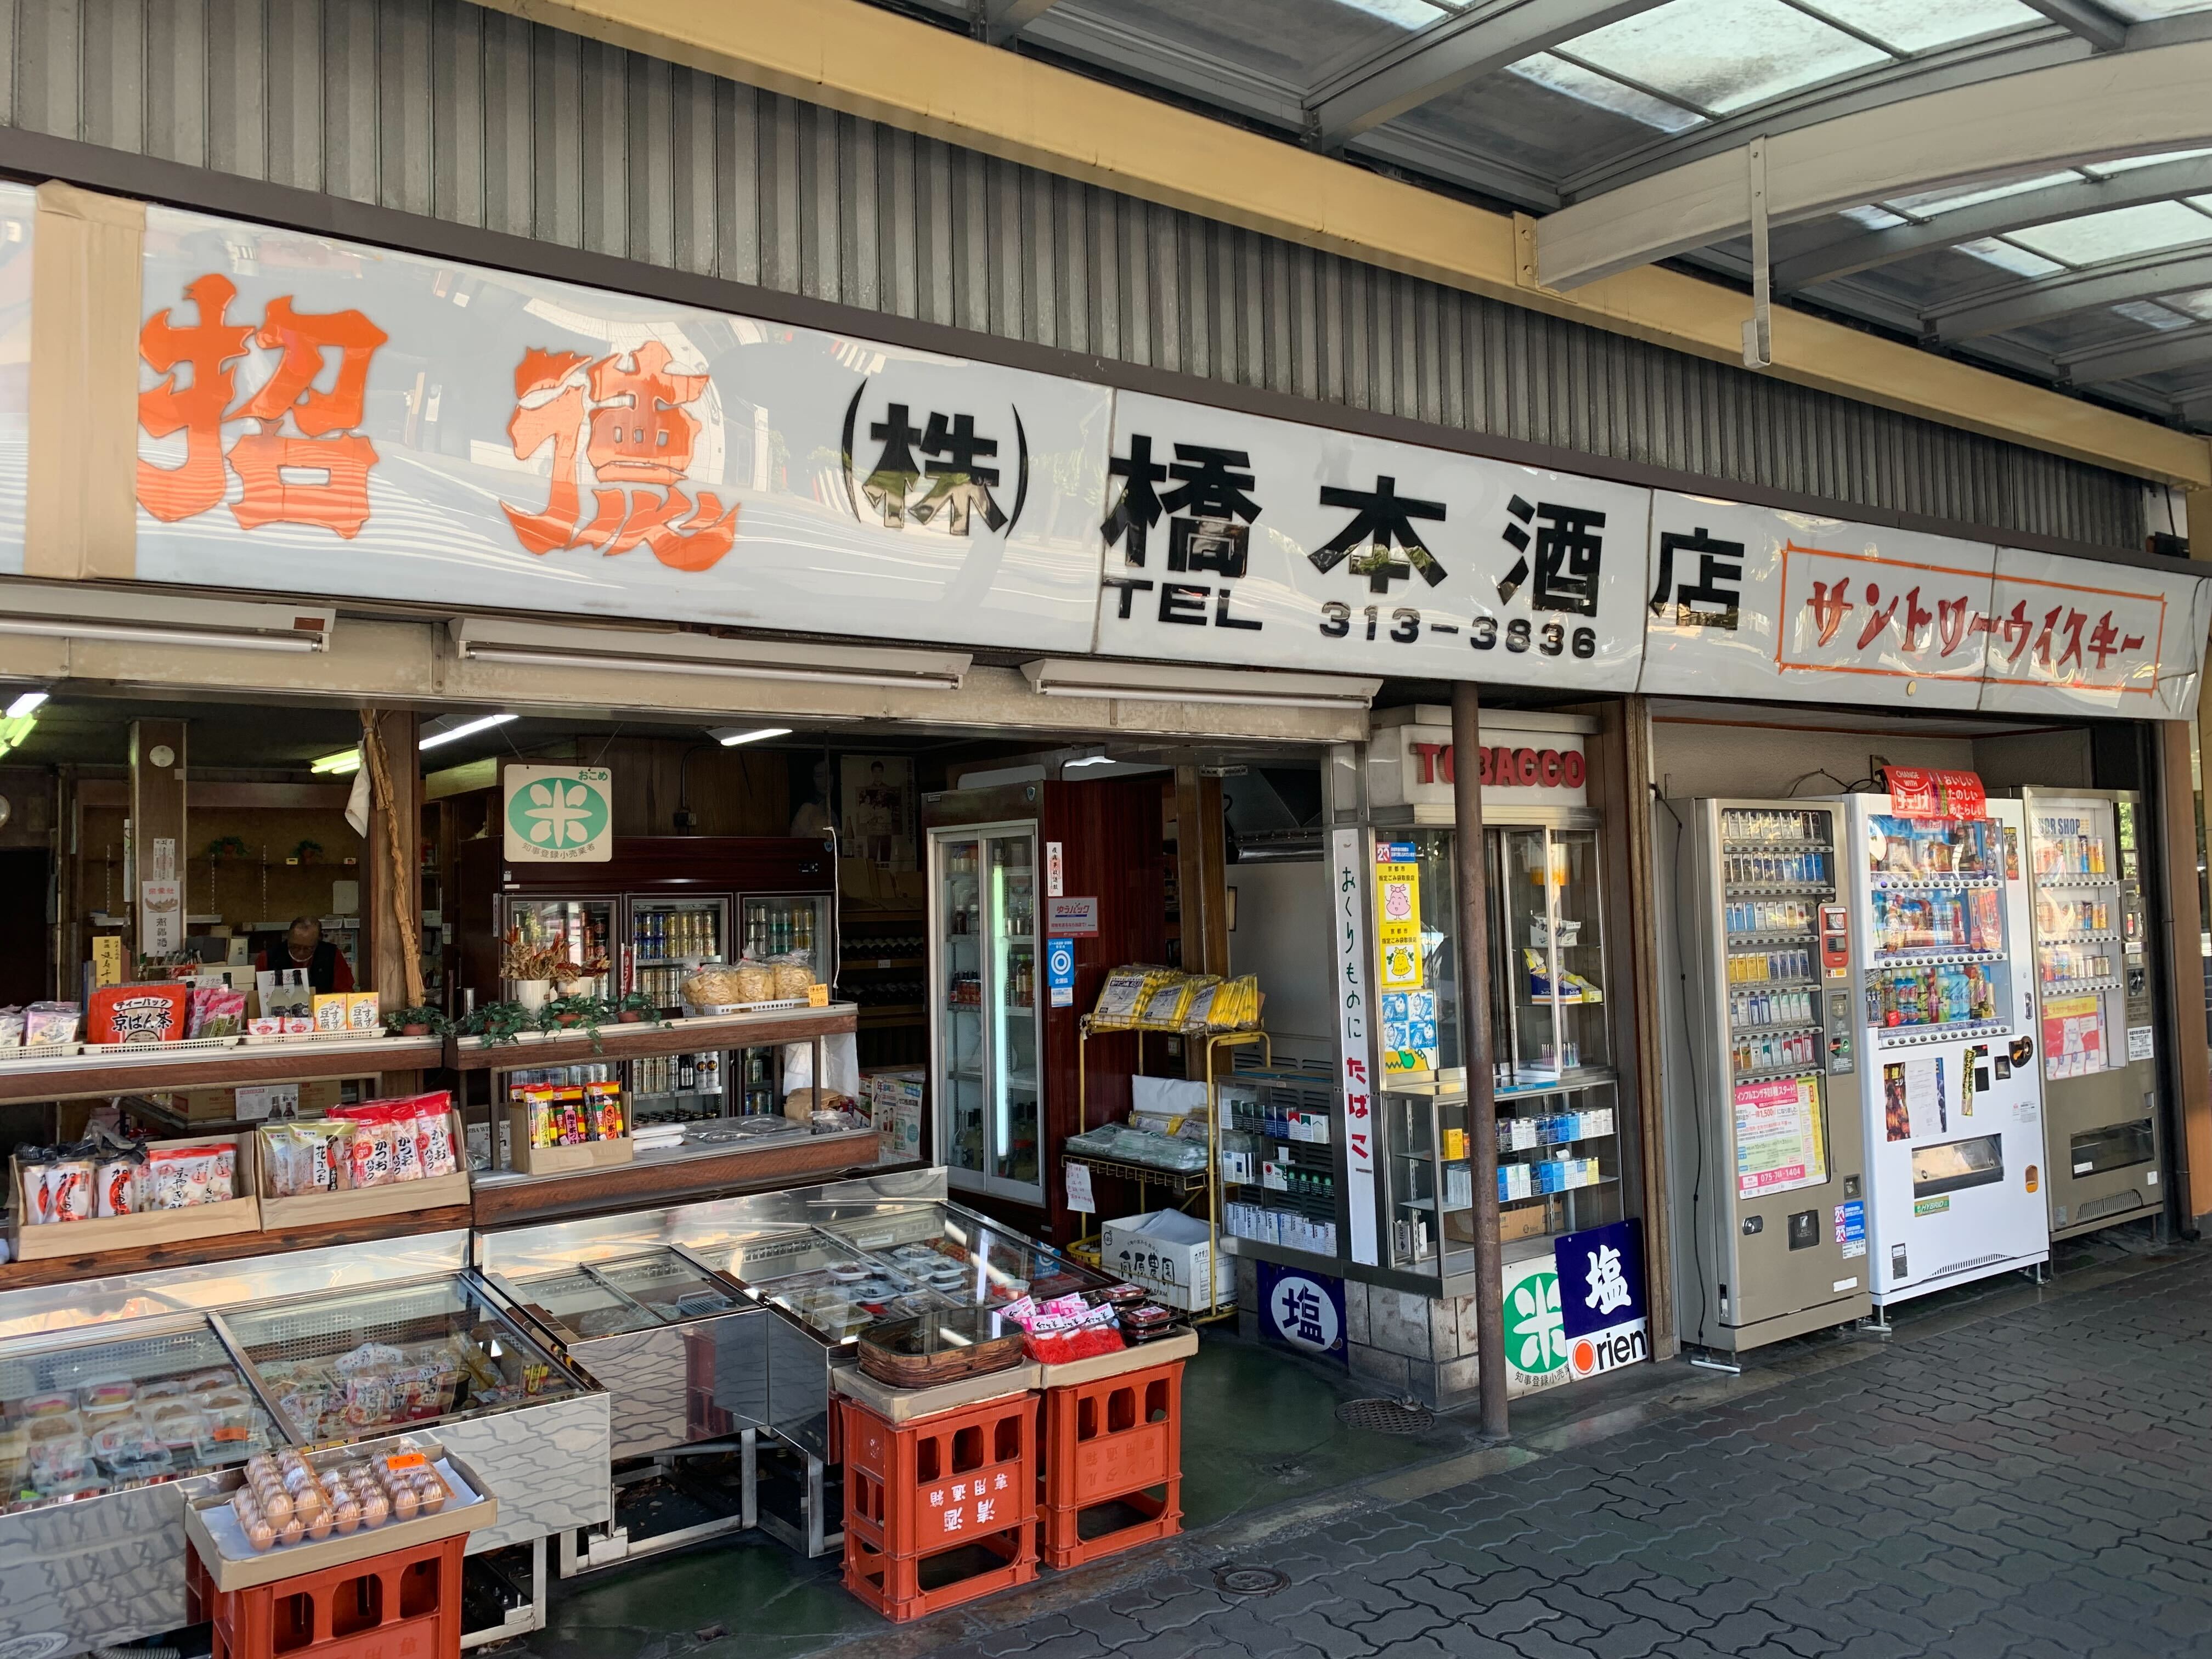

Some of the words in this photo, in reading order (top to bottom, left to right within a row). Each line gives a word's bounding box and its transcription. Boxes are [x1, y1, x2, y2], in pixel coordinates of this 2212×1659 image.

[1102, 580, 1263, 631] TEL
[1807, 577, 2144, 670] サントリーウイスキー
[578, 770, 608, 781] おこめ
[1896, 770, 1920, 779] CHANGE
[1944, 774, 1974, 786] おいしい
[1897, 787, 1929, 810] チェリオ
[1948, 789, 1978, 800] たのしい
[1949, 804, 1984, 816] あたらしい
[2057, 817, 2080, 835] SHOP
[522, 842, 596, 859] 知事登録小売業者
[1057, 902, 1090, 913] ゆうパック
[1342, 866, 1362, 1038] おくりものに
[112, 1011, 173, 1031] 京ばん茶
[320, 1008, 330, 1029] 豆腐
[353, 1006, 363, 1028] 豆腐
[1346, 1057, 1369, 1159] たばこ
[375, 1140, 387, 1171] かつお
[398, 1136, 414, 1166] かつお
[431, 1130, 446, 1160] かつお
[315, 1145, 326, 1183] 花かつお
[365, 1159, 376, 1180] パック
[1922, 1201, 1944, 1212] HYBRID
[1585, 1244, 1632, 1315] 塩
[1282, 1284, 1325, 1346] 塩
[944, 1498, 996, 1532] 清酒
